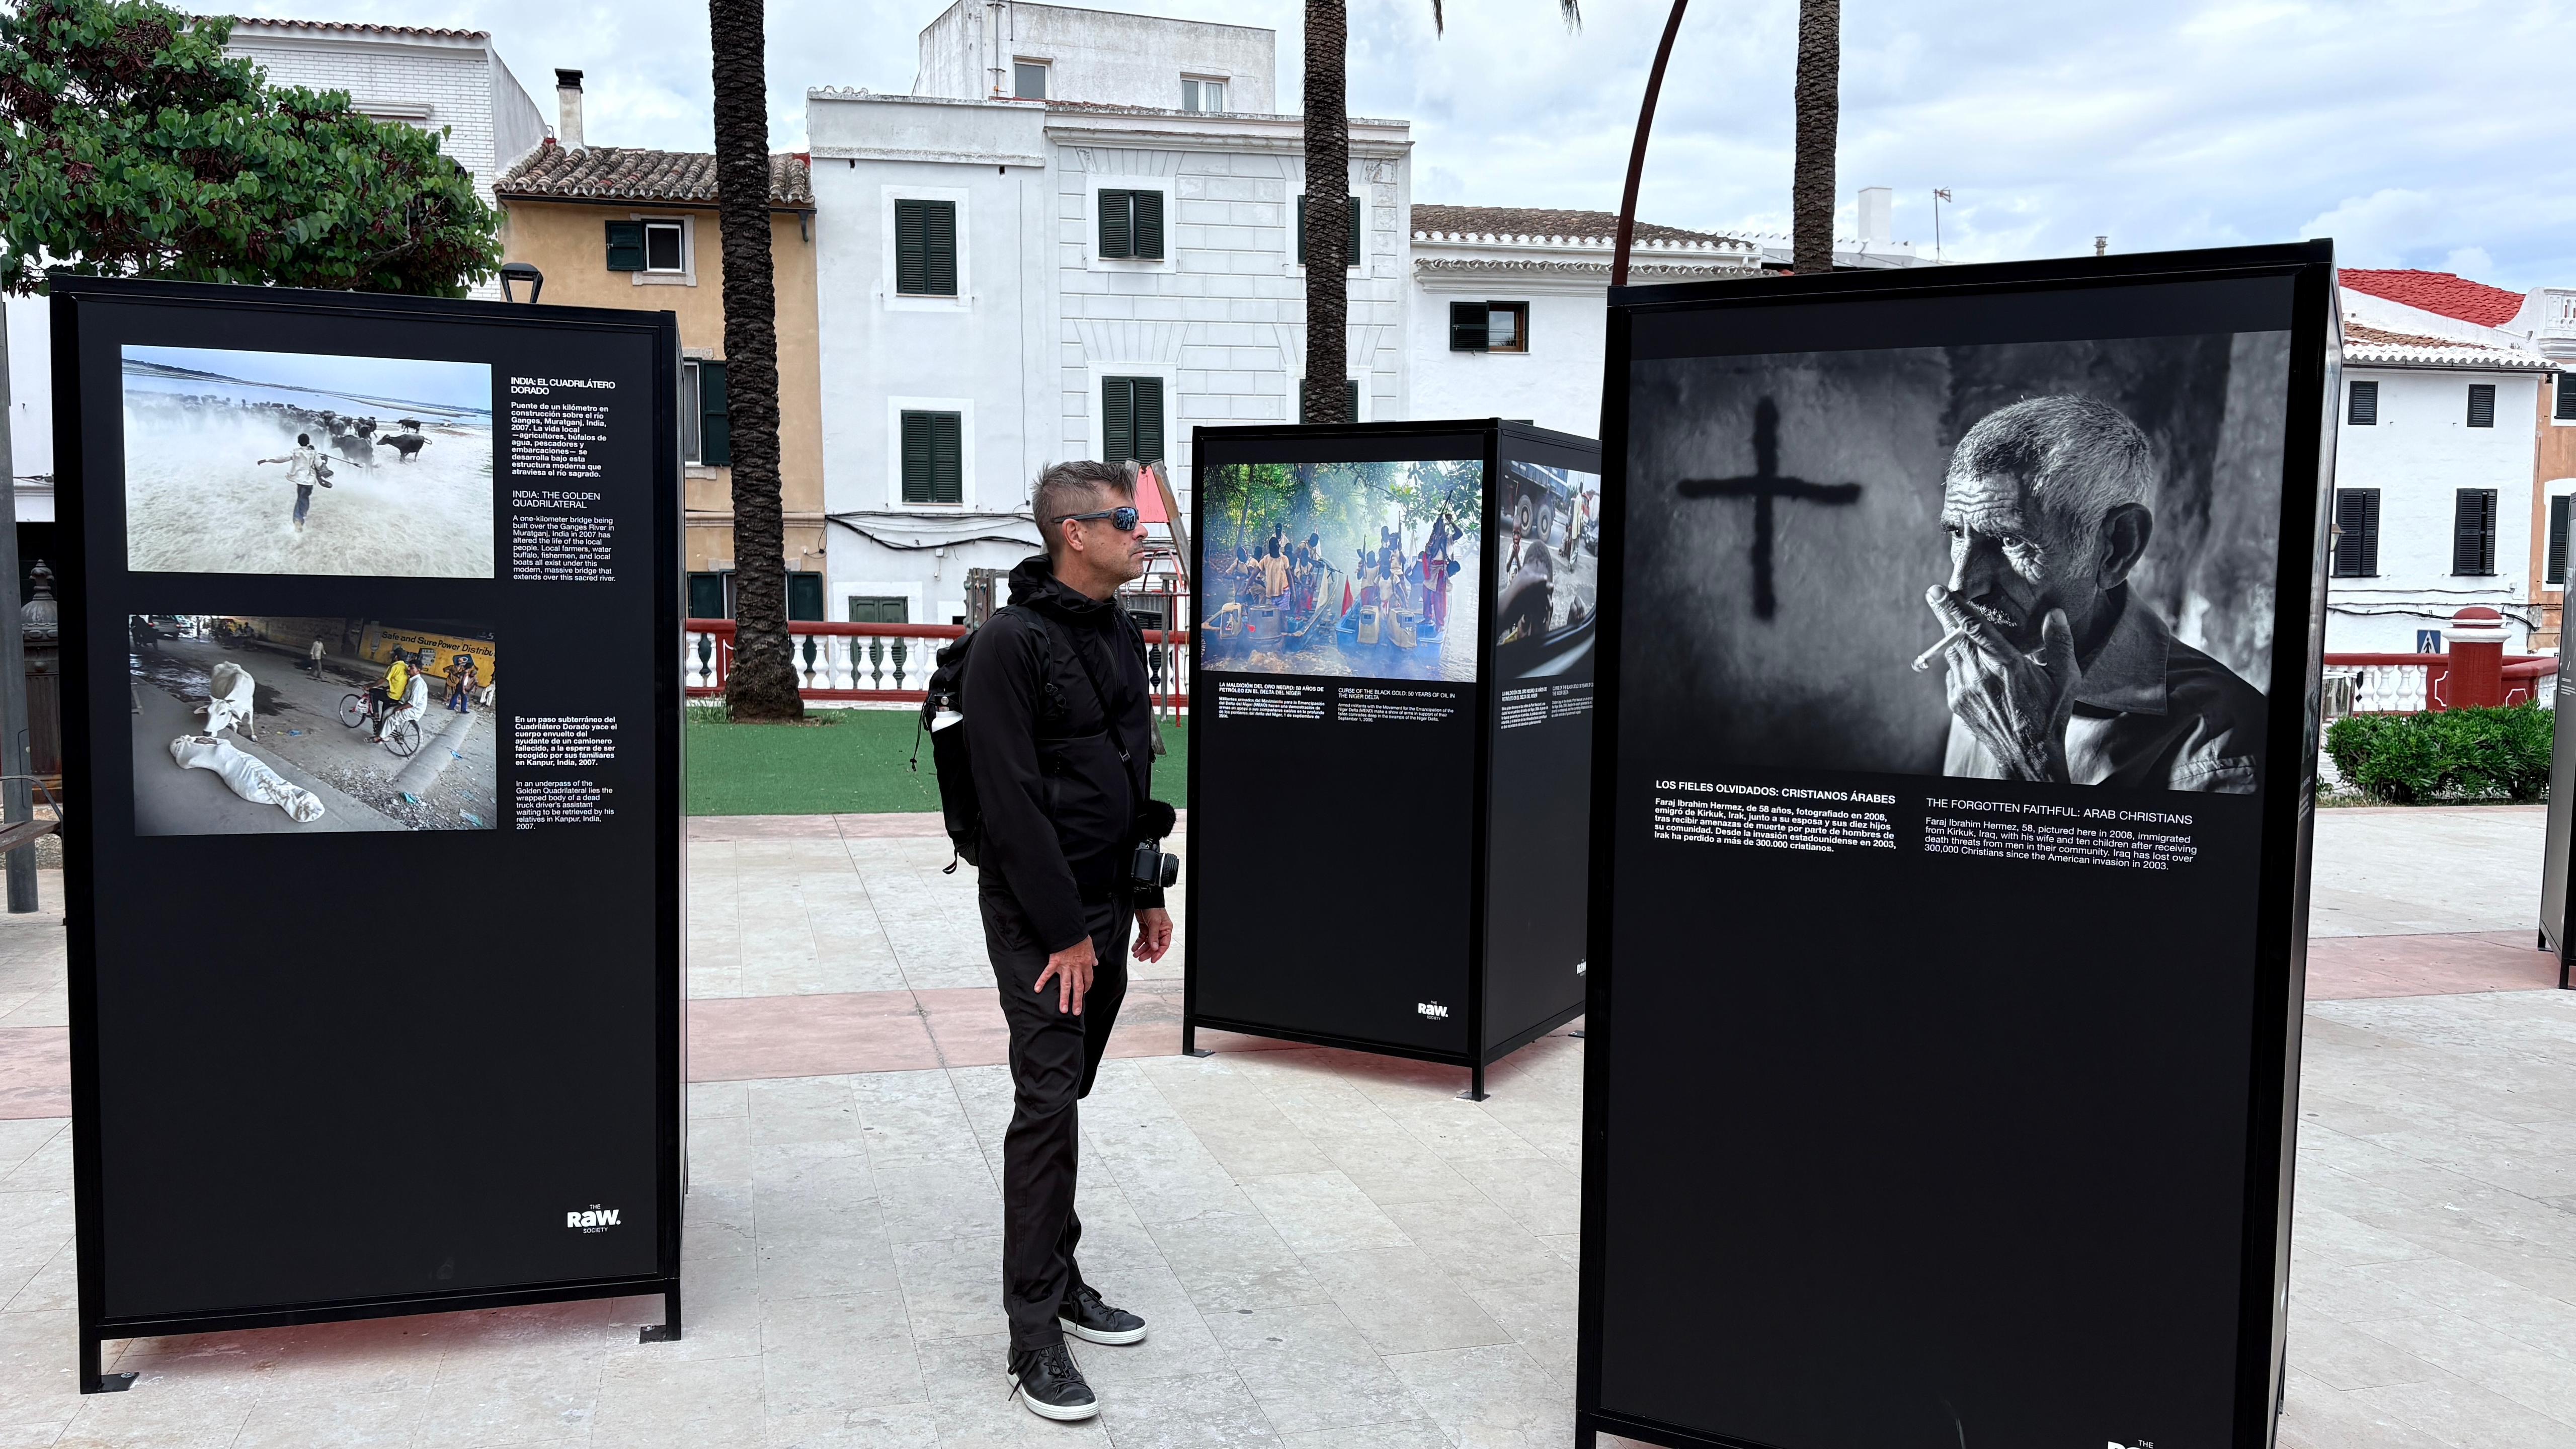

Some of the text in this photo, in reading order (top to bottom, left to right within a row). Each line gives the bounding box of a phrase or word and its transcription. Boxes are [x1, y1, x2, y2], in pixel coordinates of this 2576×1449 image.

[511, 377, 536, 385] INDIA:
[549, 379, 615, 389] CUADRILÁTERO
[511, 386, 549, 395] DORADO
[544, 418, 584, 427] Muratganj,
[513, 491, 600, 501] INDIA: THE GOLDEN
[513, 500, 587, 509] QUADRILATERAL
[382, 631, 399, 640] Safe
[417, 636, 437, 647] Sure
[437, 639, 460, 651] Power
[1656, 780, 1895, 804] LOS FIELES OLVIDADOS: CRISTIANOS ÁRABES
[1655, 797, 1675, 808] Faraj
[1677, 799, 1708, 809] Ibrahim
[1710, 801, 1744, 812] Hermez,
[1746, 804, 1756, 812] de
[1759, 805, 1769, 813] 58
[1770, 806, 1794, 816] años,
[1796, 808, 1848, 819] fotografiado
[1864, 812, 1887, 822] 2008,
[1655, 807, 1682, 816] emigró
[1697, 810, 1726, 819] Kirkuk,
[1728, 812, 1746, 821] Irak,
[1748, 813, 1769, 822] junto
[1792, 818, 1822, 826] esposa
[1849, 820, 1867, 829] diez
[1870, 822, 1891, 831] hijos
[1926, 798, 2192, 825] THE FORGOTTEN FAITHFUL: ARAB CHRISTIANS
[1925, 826, 1944, 835] from
[1947, 828, 1976, 838] Kirkuk,
[1979, 830, 1997, 840] Iraq,
[2000, 832, 2018, 840] with
[2021, 833, 2034, 841] his
[2036, 835, 2054, 843] wife
[2076, 837, 2089, 845] ten
[2092, 838, 2128, 848] children
[2131, 841, 2152, 850] after
[2155, 844, 2197, 854] receiving
[1926, 817, 2190, 843] Faraj Ibrahim Hermez, 58, pictured here in 2008, immigrated
[1924, 844, 1958, 854] 300,000
[1961, 847, 2003, 857] Christians
[2006, 850, 2029, 859] since
[2032, 852, 2045, 860] the
[2048, 853, 2089, 864] American
[2092, 857, 2129, 867] invasion
[2143, 860, 2168, 870] 2003.
[1925, 835, 1949, 844] death
[1951, 837, 1980, 847] threats
[1983, 840, 2002, 848] from
[2027, 843, 2034, 851] in
[2037, 844, 2056, 852] their
[2059, 847, 2110, 857] community.
[2113, 849, 2130, 859] Iraq
[2133, 851, 2150, 859] has
[2153, 852, 2169, 861] lost
[2138, 1439, 2154, 1448] THE
